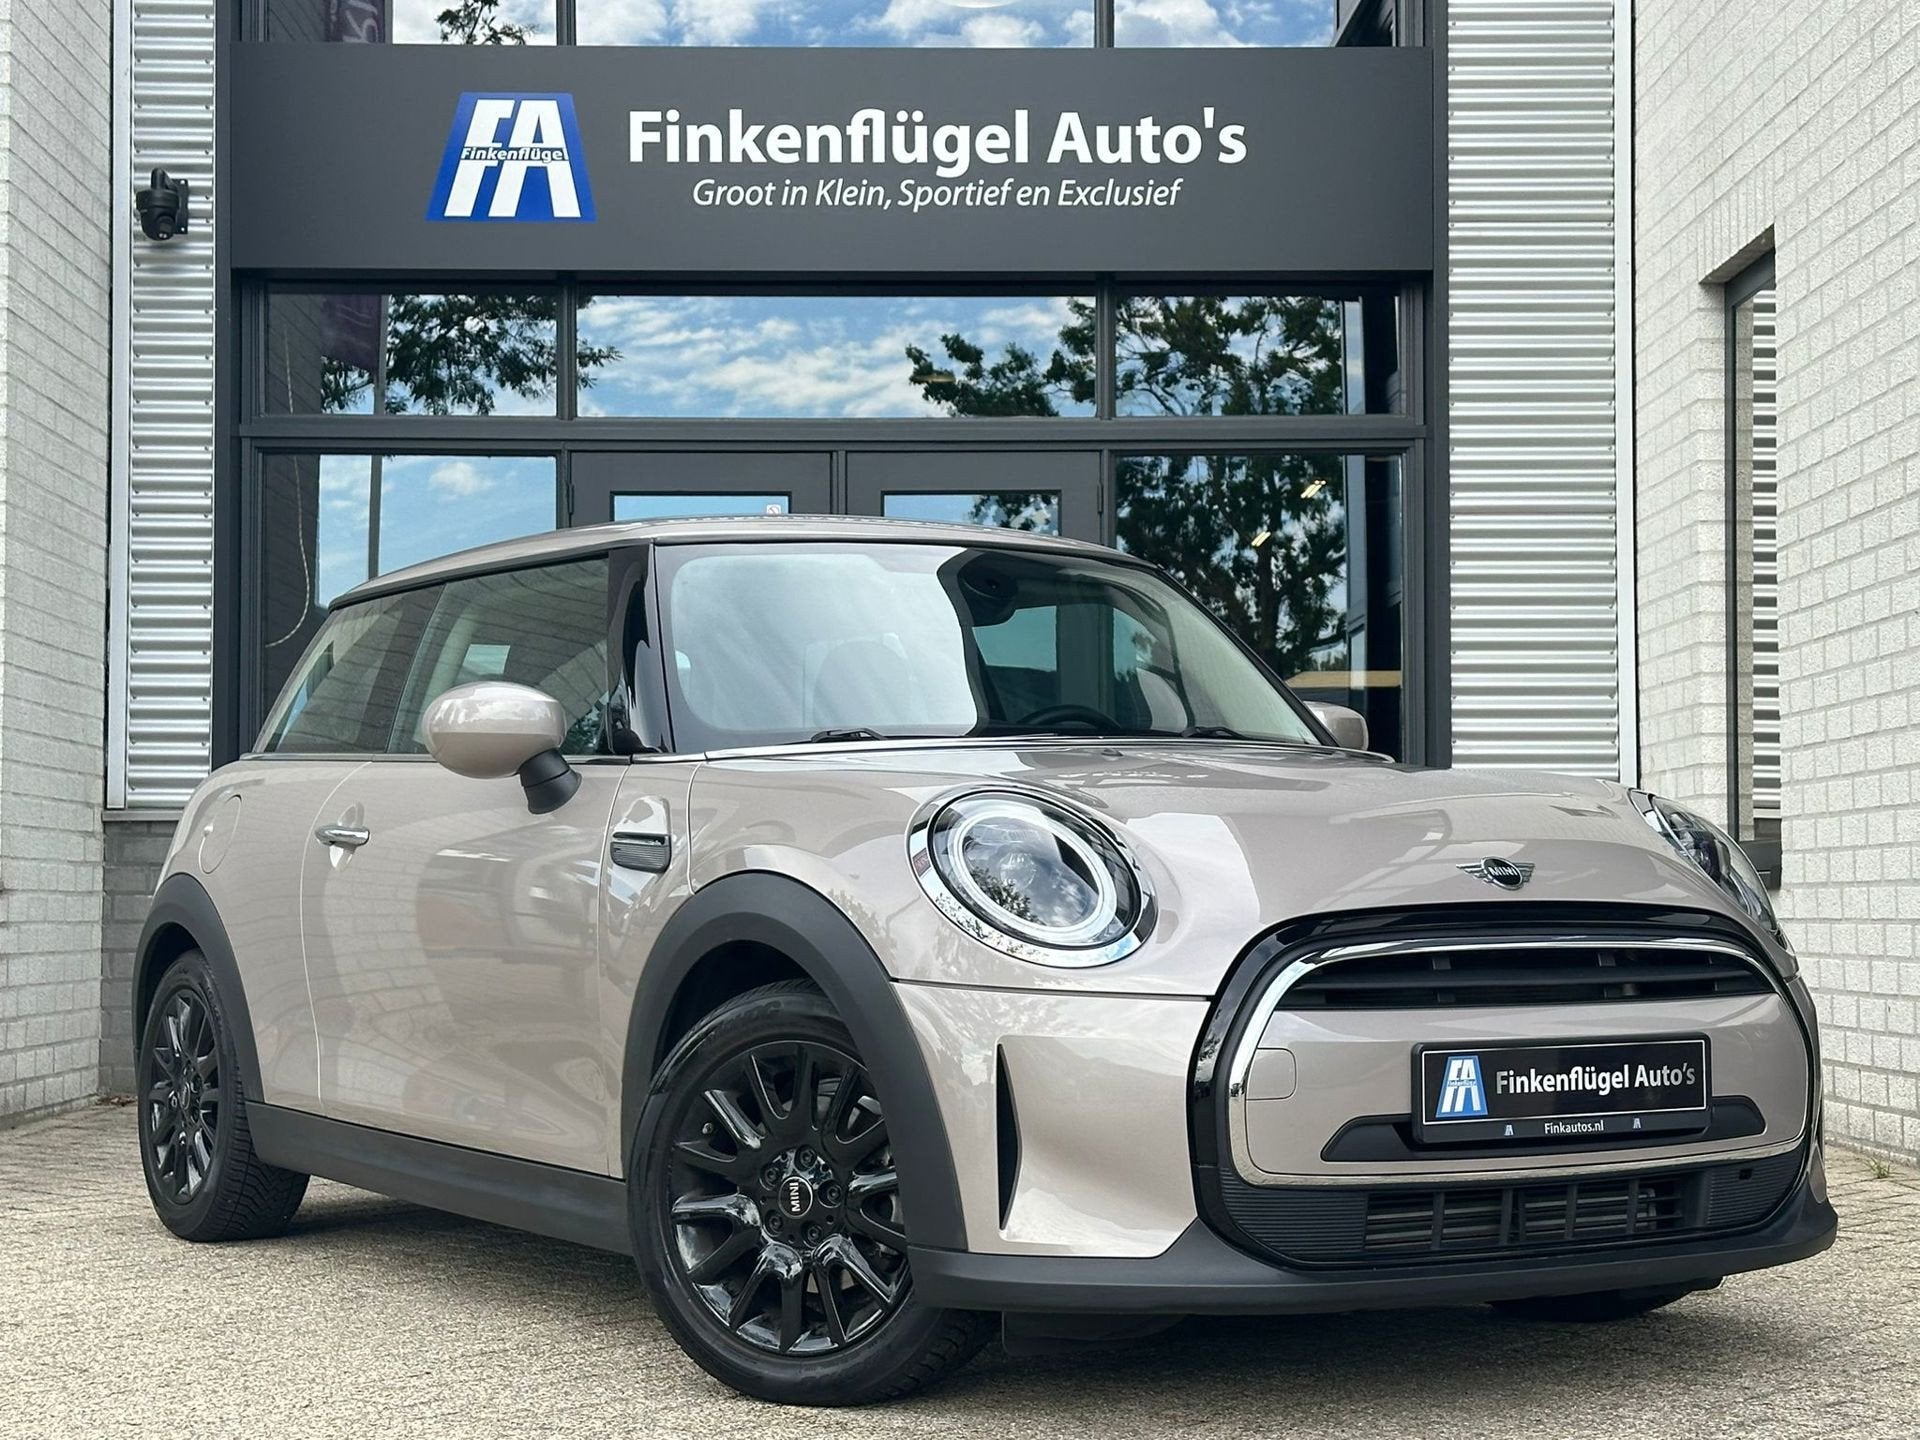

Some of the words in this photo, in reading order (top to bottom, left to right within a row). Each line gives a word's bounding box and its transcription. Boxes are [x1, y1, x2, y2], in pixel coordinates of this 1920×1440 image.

[460, 146, 569, 163] Finkenflügel
[628, 107, 1030, 178] Finkenflügel
[1045, 106, 1248, 165] Auto's
[692, 178, 777, 207] Groot
[781, 178, 808, 207] in
[815, 177, 892, 211] Klein,
[897, 177, 1015, 214] Sportief
[1015, 184, 1051, 207] en
[1057, 177, 1185, 207] Exclusief
[1487, 866, 1518, 876] MINI
[1496, 1063, 1630, 1096] Finkenflügel
[1544, 1119, 1605, 1135] Finkautos.nl
[789, 1181, 801, 1212] MINI
